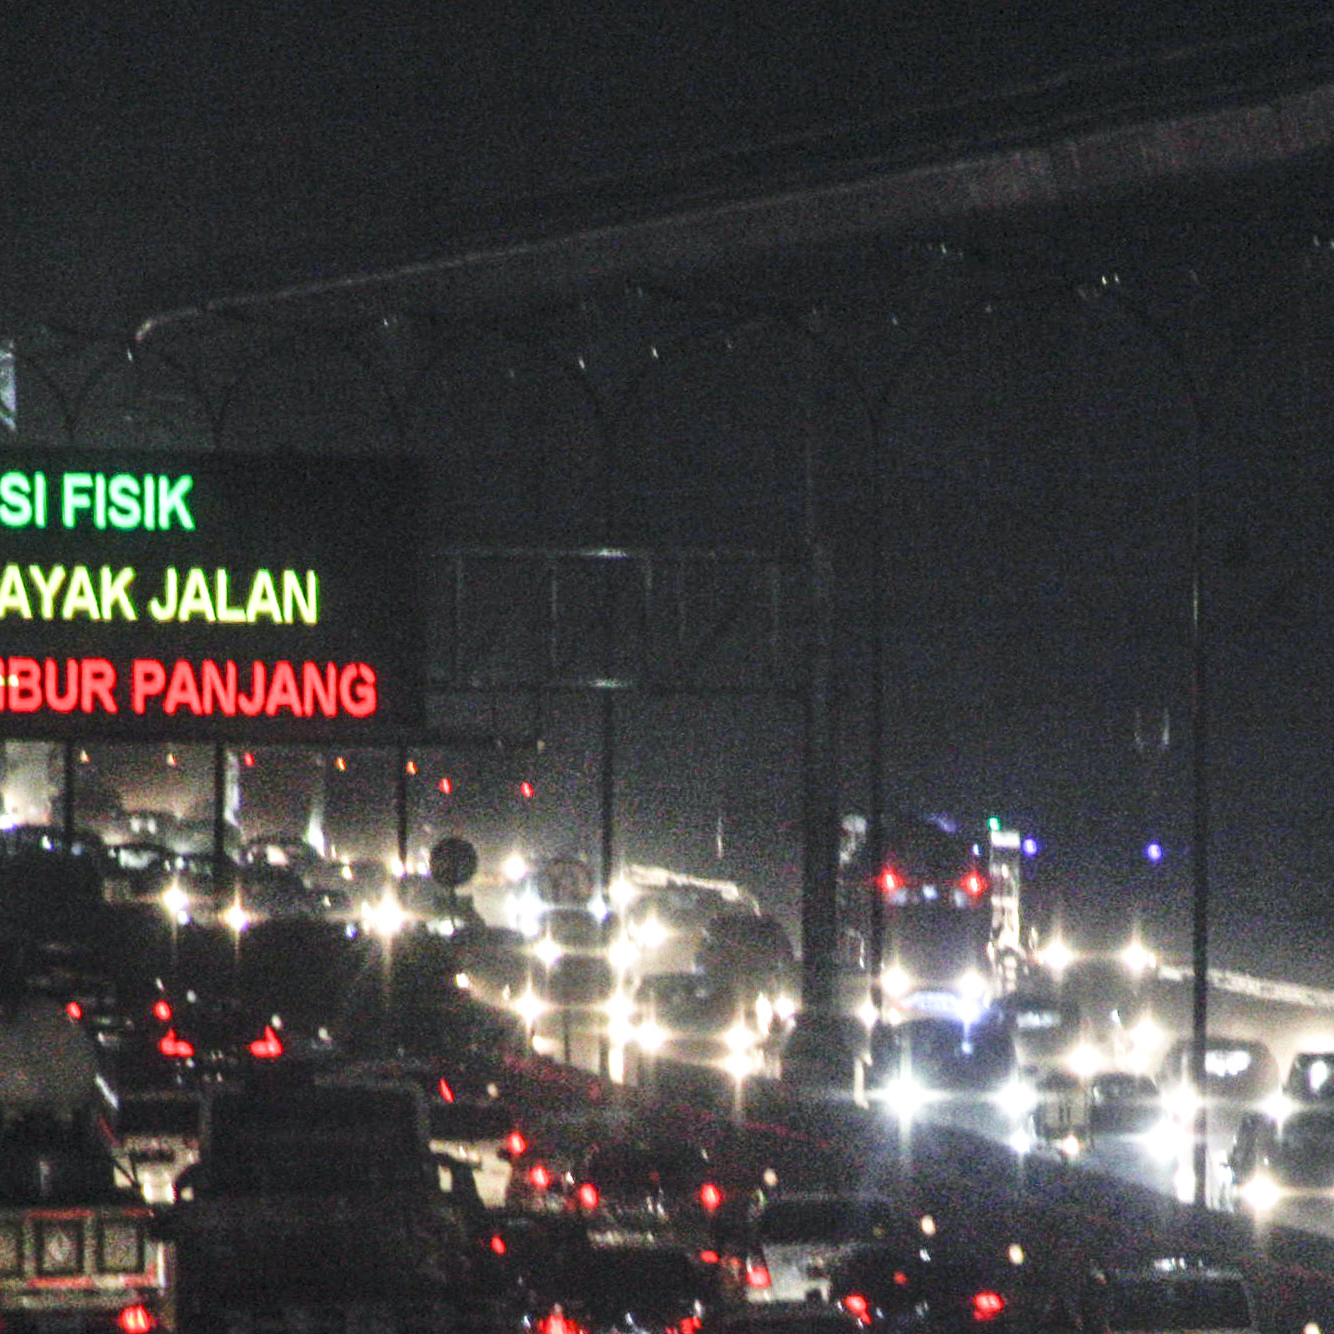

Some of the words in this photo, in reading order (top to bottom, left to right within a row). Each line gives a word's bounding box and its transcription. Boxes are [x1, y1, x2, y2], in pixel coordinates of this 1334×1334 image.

[60, 472, 195, 531] FISIK
[147, 567, 319, 625] JALAN
[129, 659, 378, 718] PANJANG
